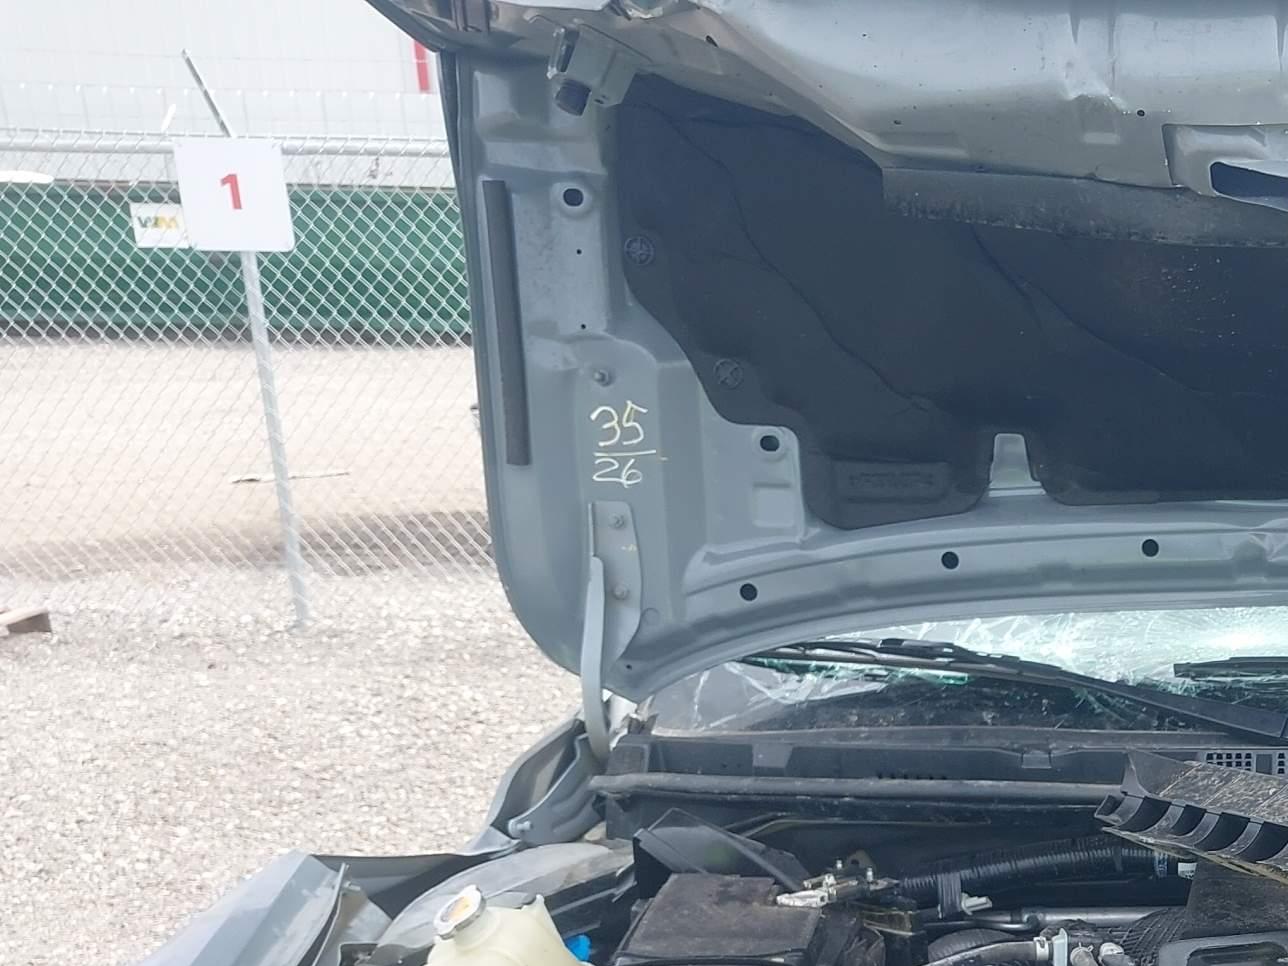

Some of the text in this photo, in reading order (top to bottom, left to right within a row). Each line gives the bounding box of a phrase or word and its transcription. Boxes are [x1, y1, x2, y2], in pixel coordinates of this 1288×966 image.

[219, 173, 243, 210] 1
[590, 400, 648, 447] 35
[592, 457, 643, 488] 26
